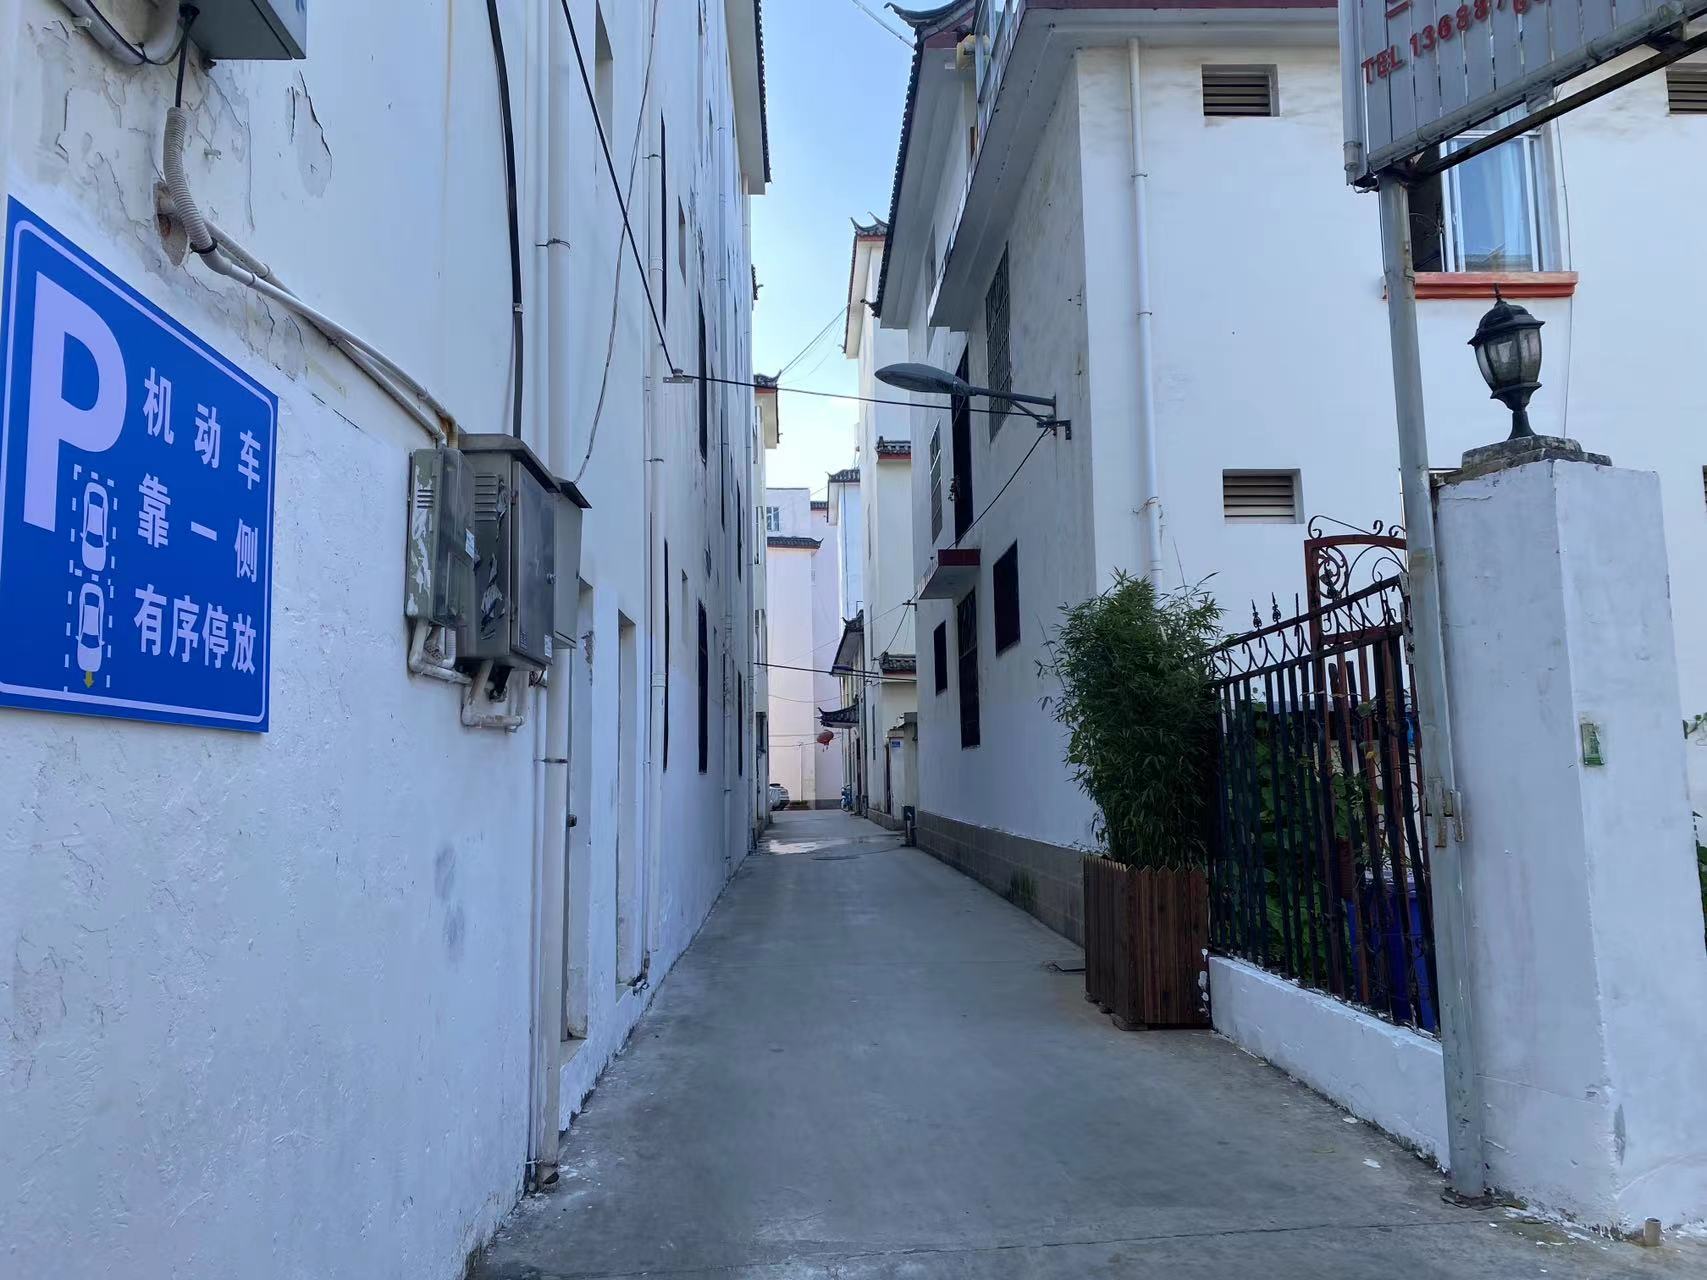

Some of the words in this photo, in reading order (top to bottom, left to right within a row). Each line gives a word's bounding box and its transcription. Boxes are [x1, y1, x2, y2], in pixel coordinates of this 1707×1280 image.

[1361, 45, 1404, 84] TEL
[24, 271, 127, 533] P
[143, 367, 261, 490] 机动车
[138, 473, 258, 583] 靠一侧
[134, 583, 257, 674] 有序停放
